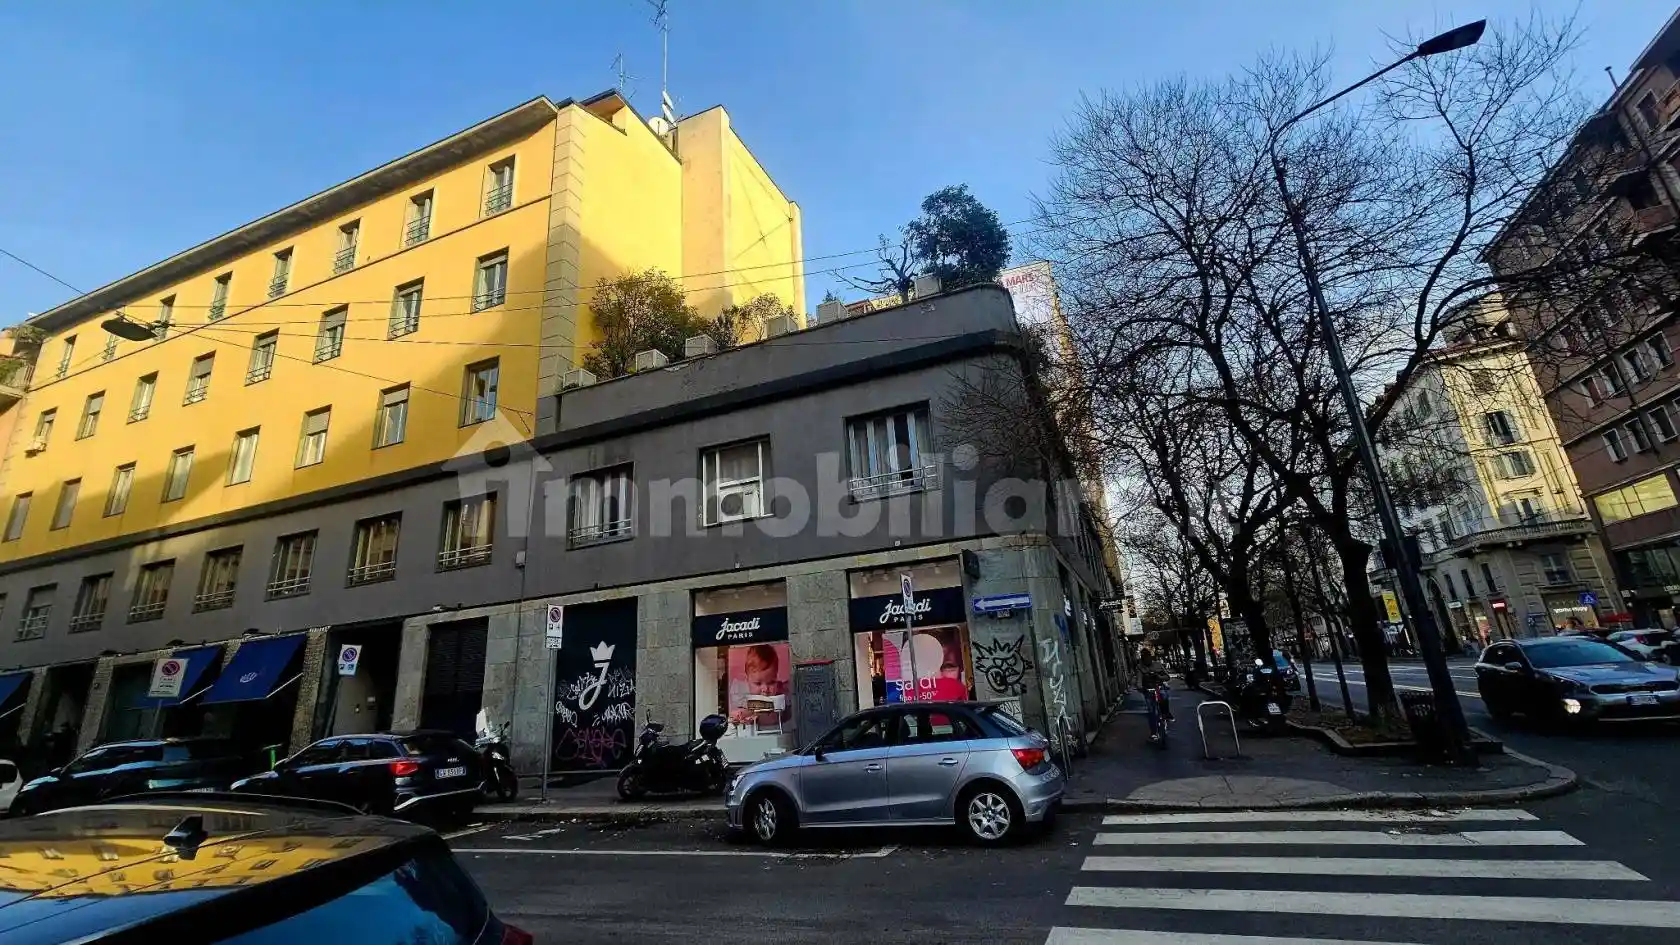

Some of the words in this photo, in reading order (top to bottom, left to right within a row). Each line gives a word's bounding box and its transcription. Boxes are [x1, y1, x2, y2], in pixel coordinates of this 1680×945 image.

[893, 614, 923, 623] PAIS
[716, 617, 760, 640] jacadi
[727, 632, 753, 640] PARIS
[895, 672, 937, 691] sadi
